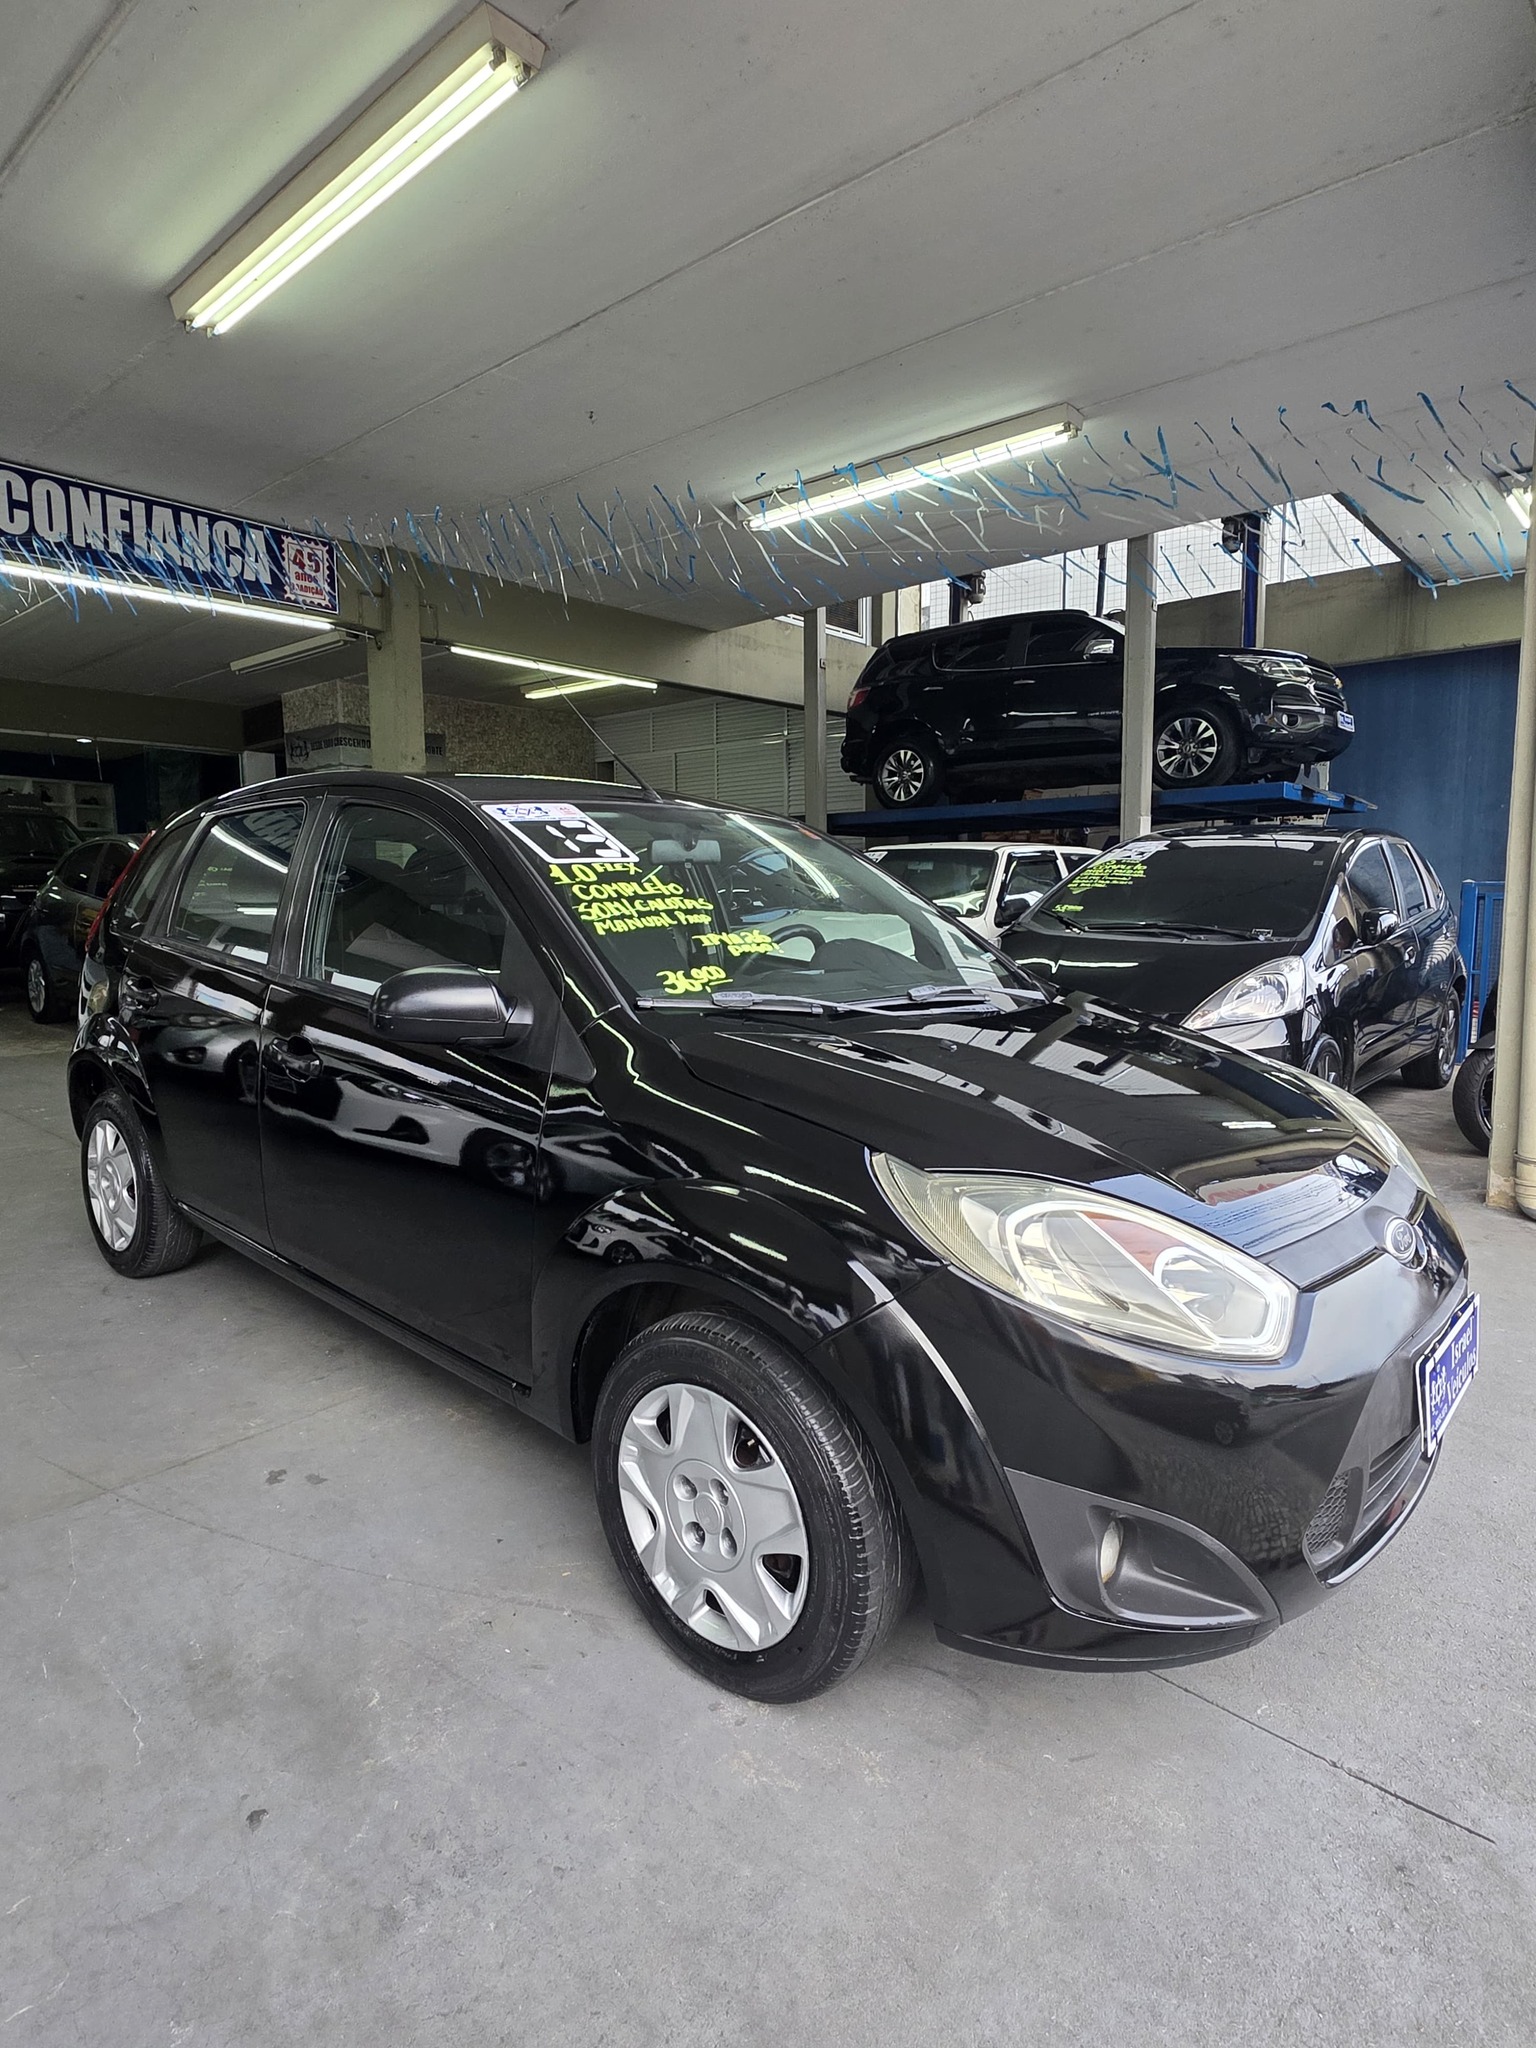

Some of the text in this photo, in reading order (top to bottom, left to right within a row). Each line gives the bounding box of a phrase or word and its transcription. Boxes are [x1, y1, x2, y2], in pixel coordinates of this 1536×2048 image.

[293, 549, 320, 573] 45
[549, 862, 643, 884] 1.0 FLEX
[594, 912, 678, 936] MANUAL
[1395, 1226, 1412, 1251] Ford
[1451, 1315, 1475, 1369] Israel
